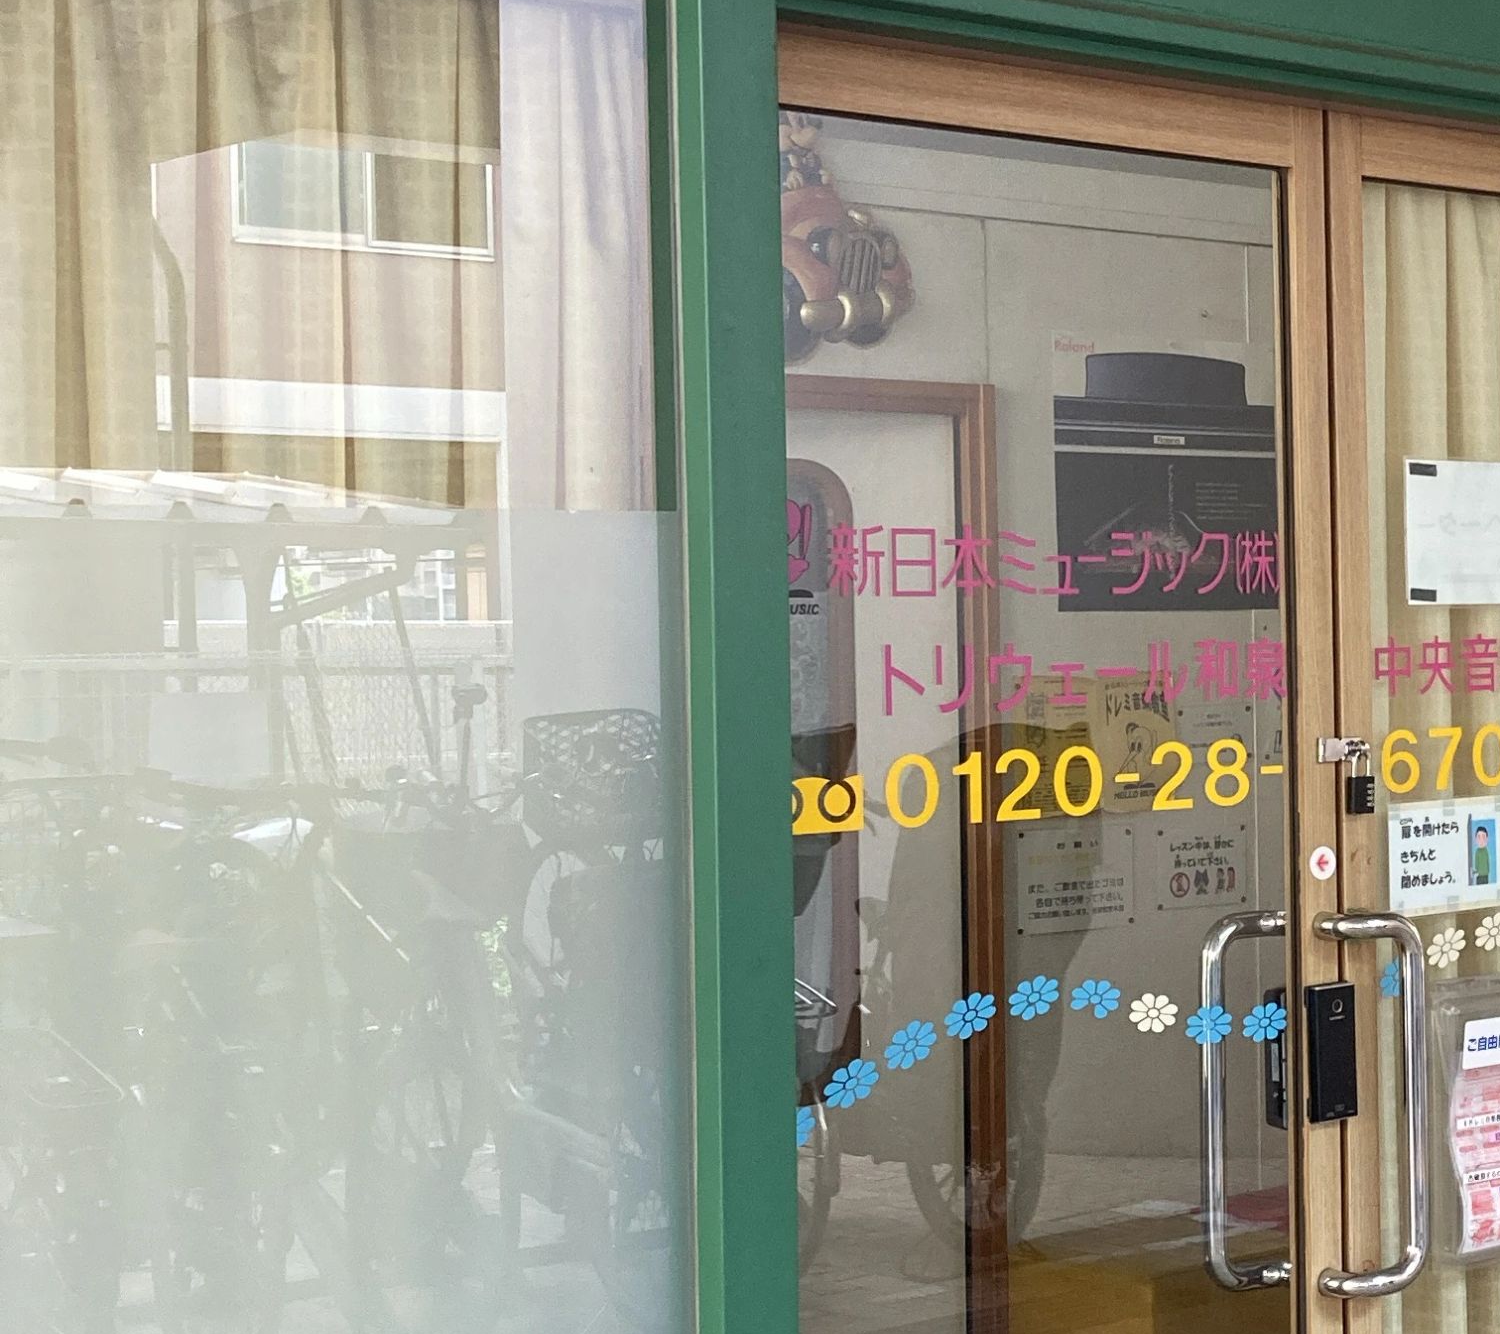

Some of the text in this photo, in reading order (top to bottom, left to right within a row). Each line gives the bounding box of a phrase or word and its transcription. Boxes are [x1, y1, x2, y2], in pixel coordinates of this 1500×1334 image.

[790, 603, 819, 616] USIC
[1401, 822, 1459, 839] 扉を開けたら
[1400, 849, 1436, 864] きちんと
